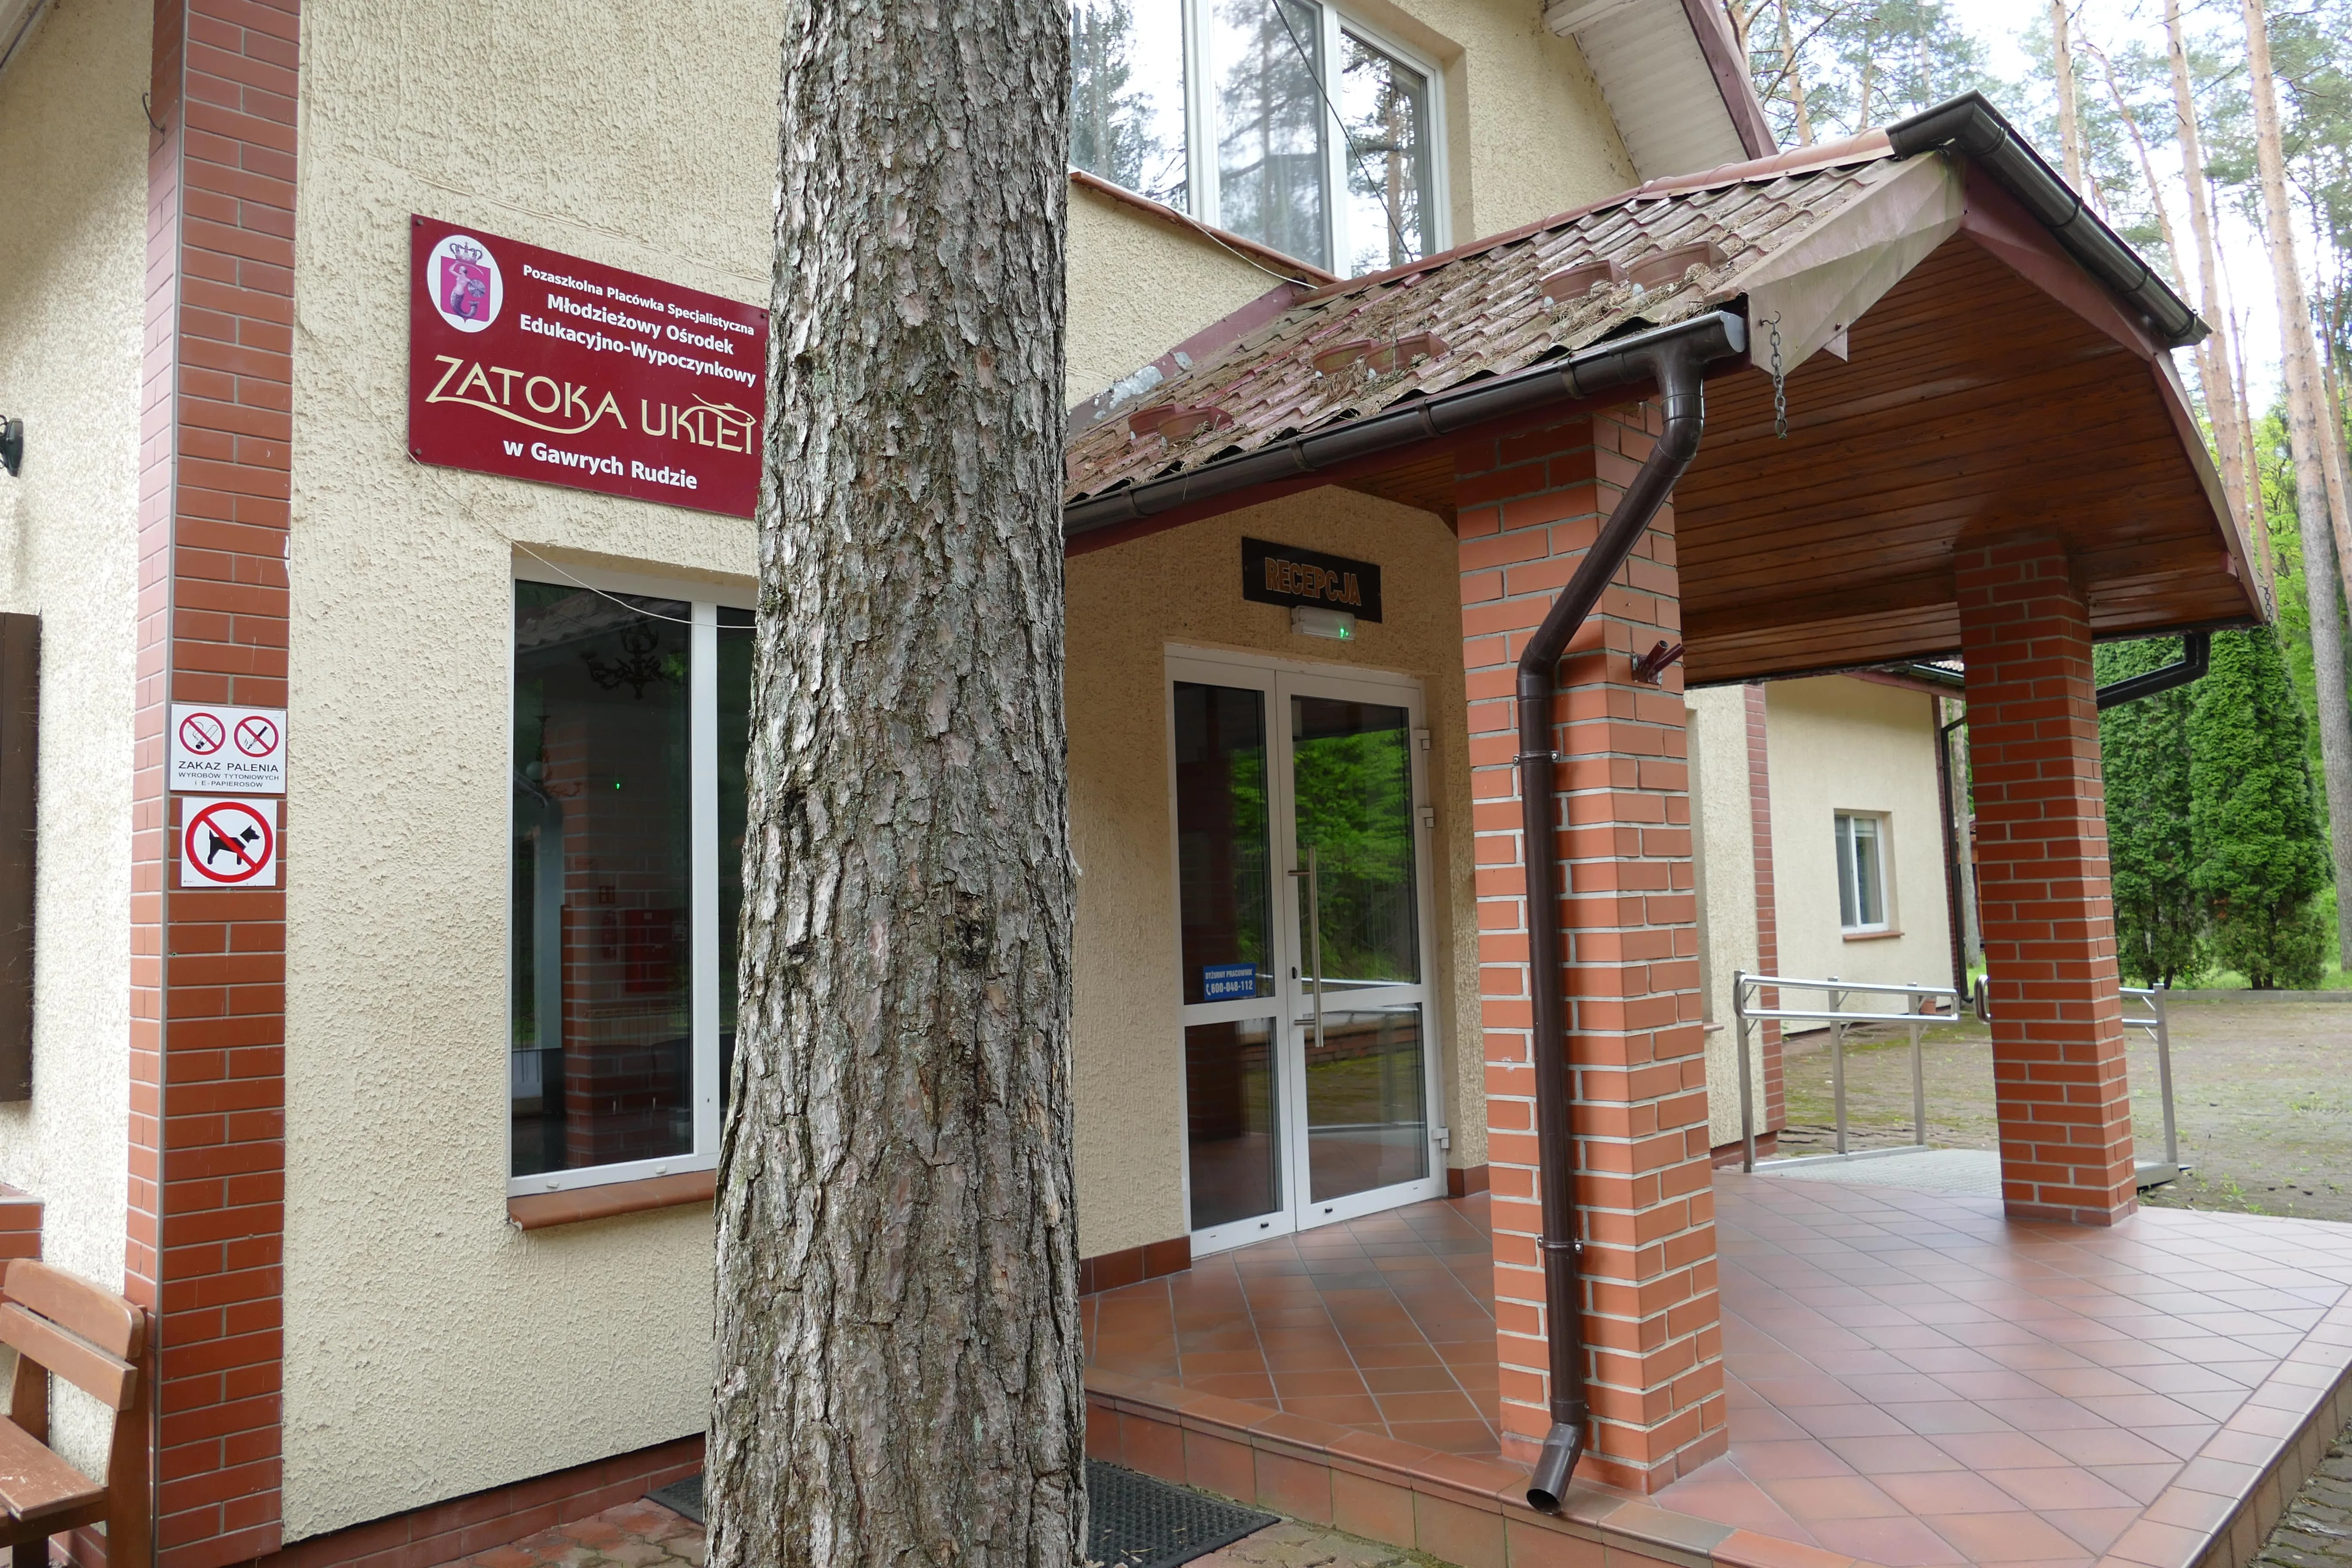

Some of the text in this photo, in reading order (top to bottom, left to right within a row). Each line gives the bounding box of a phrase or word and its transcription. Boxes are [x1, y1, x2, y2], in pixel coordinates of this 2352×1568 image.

[523, 264, 755, 336] Pozaszkolna Placówka Specjalistyczna
[548, 294, 734, 355] Młodzieżowy Ośrodek
[520, 314, 756, 388] Edukacyjno-Wypoczynkowy
[426, 355, 627, 434] ZATOKA
[504, 440, 698, 490] w Gawrych Rudzie
[1265, 557, 1362, 606] RECEPCJA
[178, 761, 279, 772] ZAKAZ PALENIA
[1205, 969, 1253, 980] DYŻURNY PRACOWNIK
[1211, 980, 1253, 994] 600-048-112
